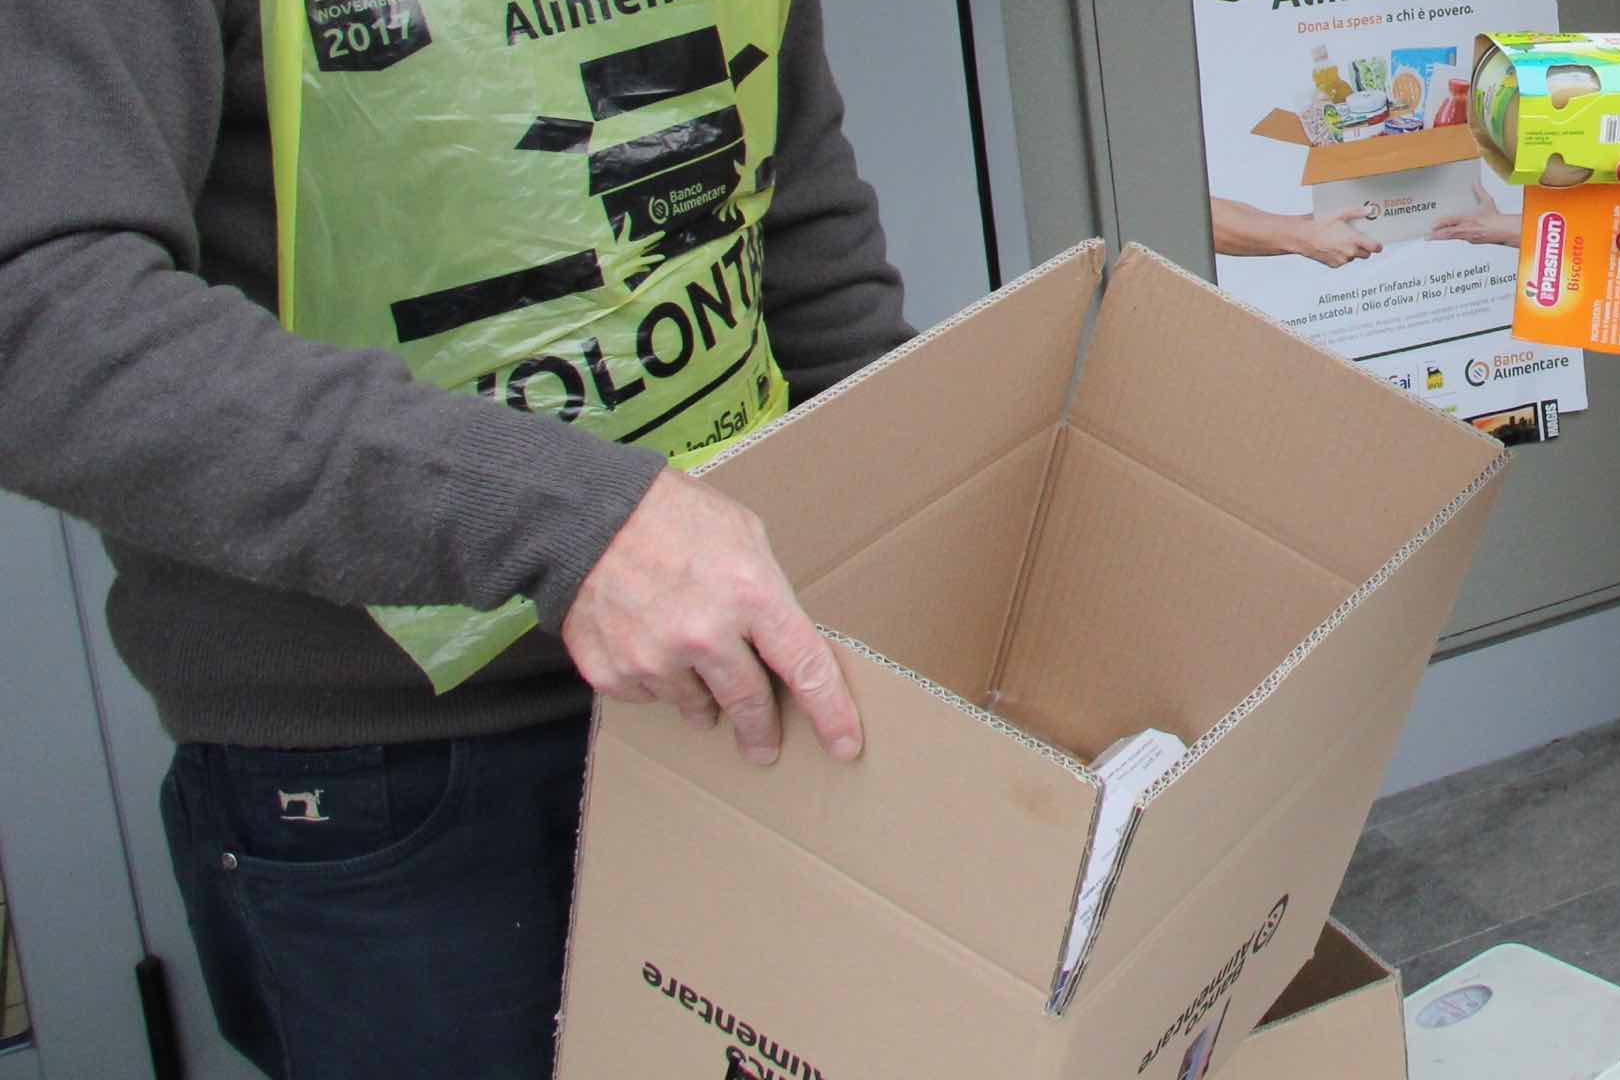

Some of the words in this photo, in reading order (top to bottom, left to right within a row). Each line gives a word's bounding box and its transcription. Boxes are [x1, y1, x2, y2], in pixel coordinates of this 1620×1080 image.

[323, 10, 411, 59] 2017
[1298, 18, 1330, 34] Dona
[1333, 18, 1345, 30] la
[1347, 14, 1384, 32] spesa
[1386, 13, 1394, 24] a
[1396, 9, 1415, 24] chi
[1418, 8, 1426, 21] è
[1428, 5, 1475, 22] povero.
[669, 182, 704, 204] Banco
[671, 183, 727, 217] Alimentare
[1383, 200, 1437, 218] Alimentare
[1541, 219, 1563, 294] Plasmon
[1567, 235, 1585, 293] Biscotto
[1309, 312, 1318, 323] in
[1319, 304, 1353, 319] scatola
[1362, 298, 1381, 312] Olio
[1383, 293, 1414, 308] d'oliva
[1422, 287, 1442, 301] Riso
[1450, 279, 1483, 295] Legumi
[1490, 272, 1517, 287] Biscot
[1318, 291, 1360, 305] Alimenti
[1361, 286, 1377, 299] per
[1429, 270, 1456, 285] Sughi
[1456, 269, 1463, 278] e
[1464, 263, 1491, 278] pelati
[1493, 350, 1534, 369] Banco
[1493, 356, 1570, 382] Alimentare
[1545, 402, 1559, 439] MAGIS
